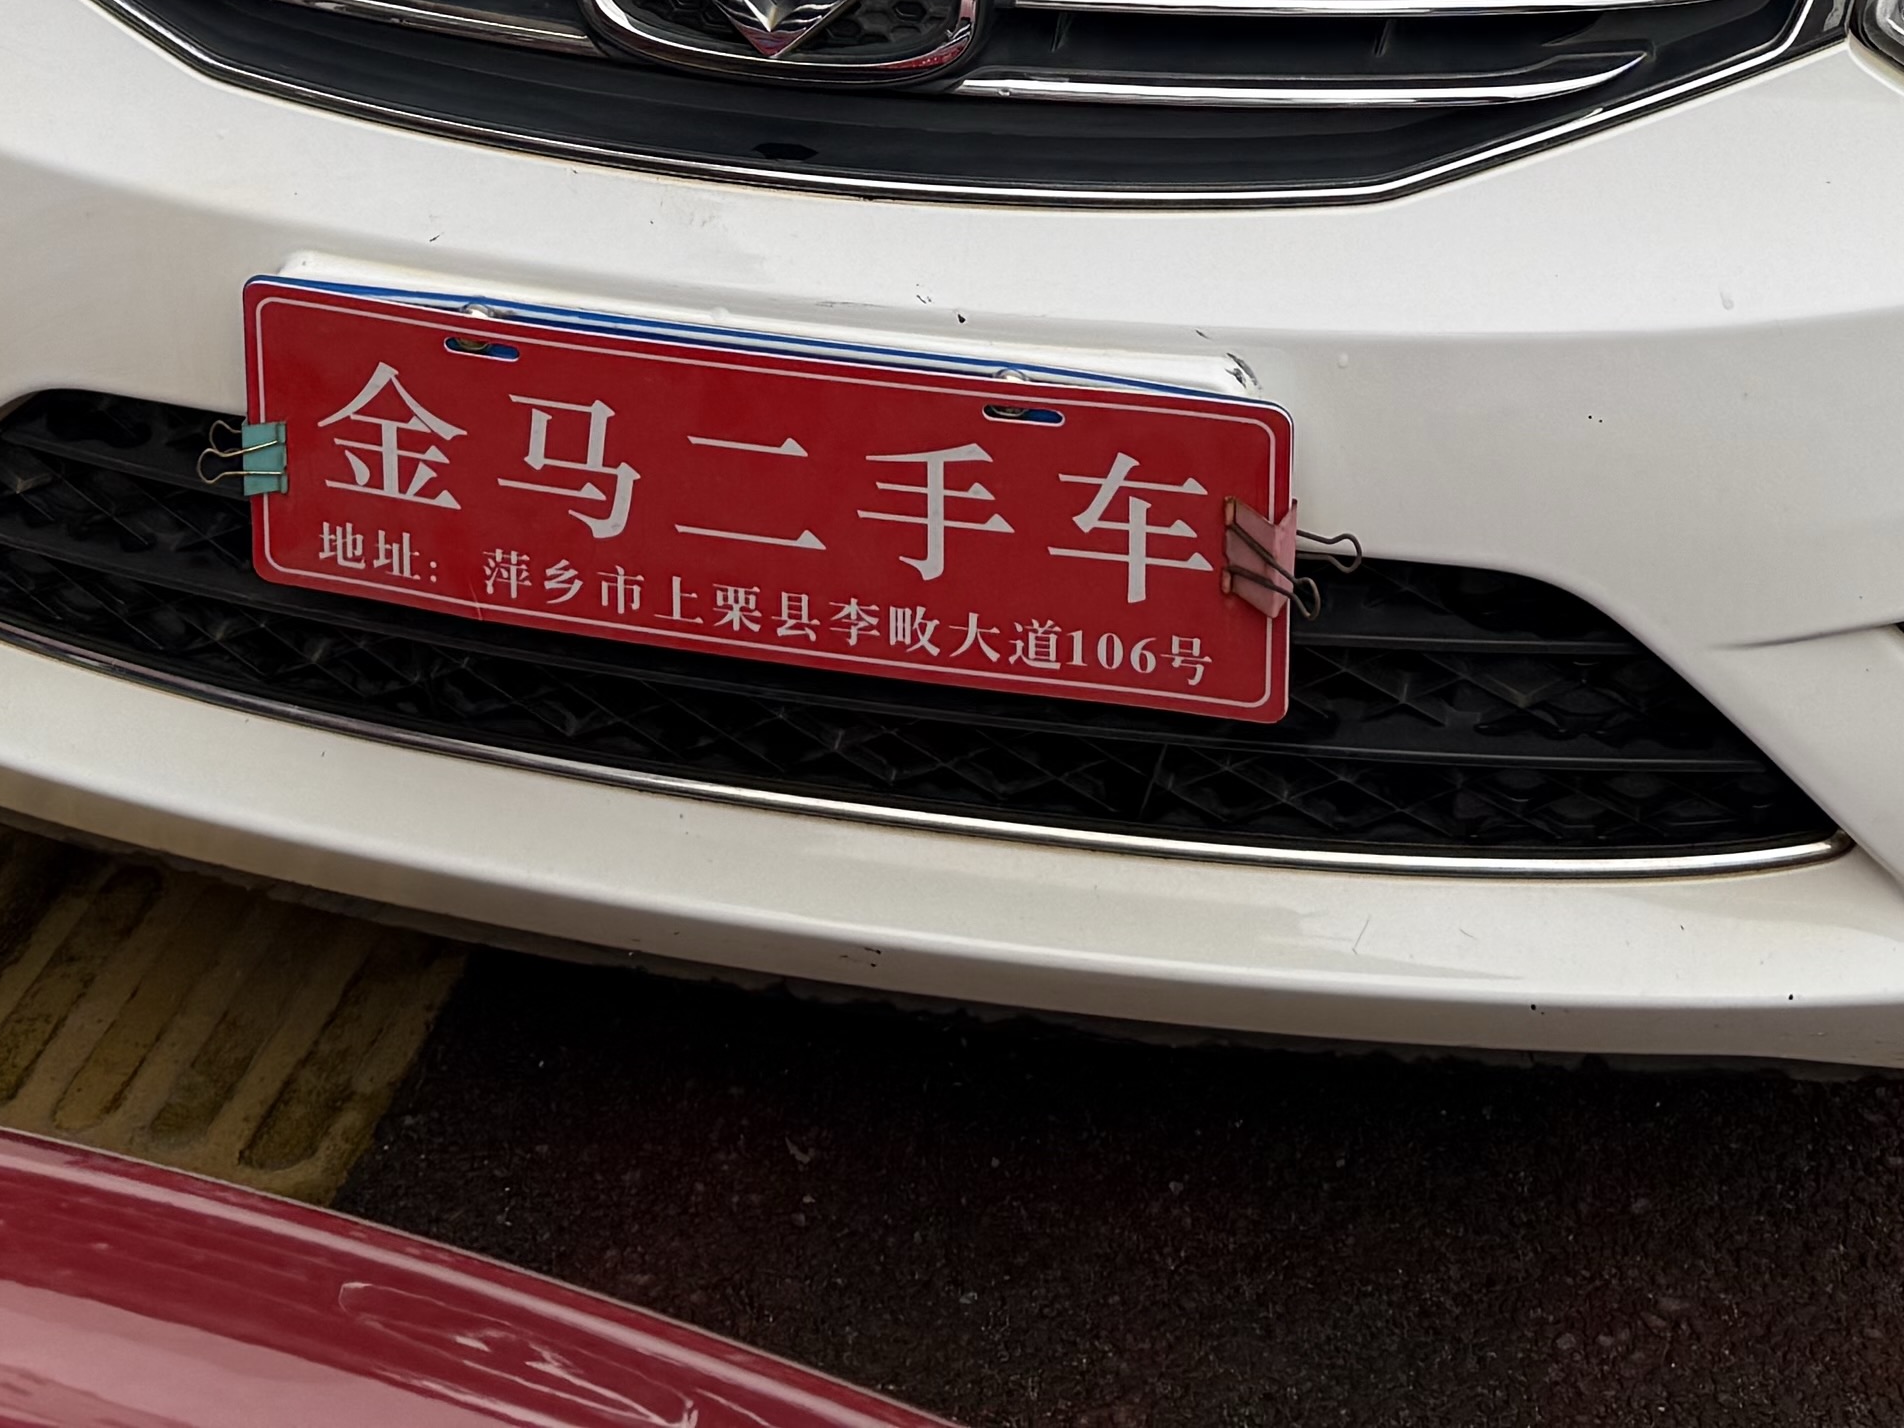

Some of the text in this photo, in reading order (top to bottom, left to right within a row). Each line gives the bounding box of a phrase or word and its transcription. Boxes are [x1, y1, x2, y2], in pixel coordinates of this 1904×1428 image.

[318, 361, 1216, 605] 金马二手车
